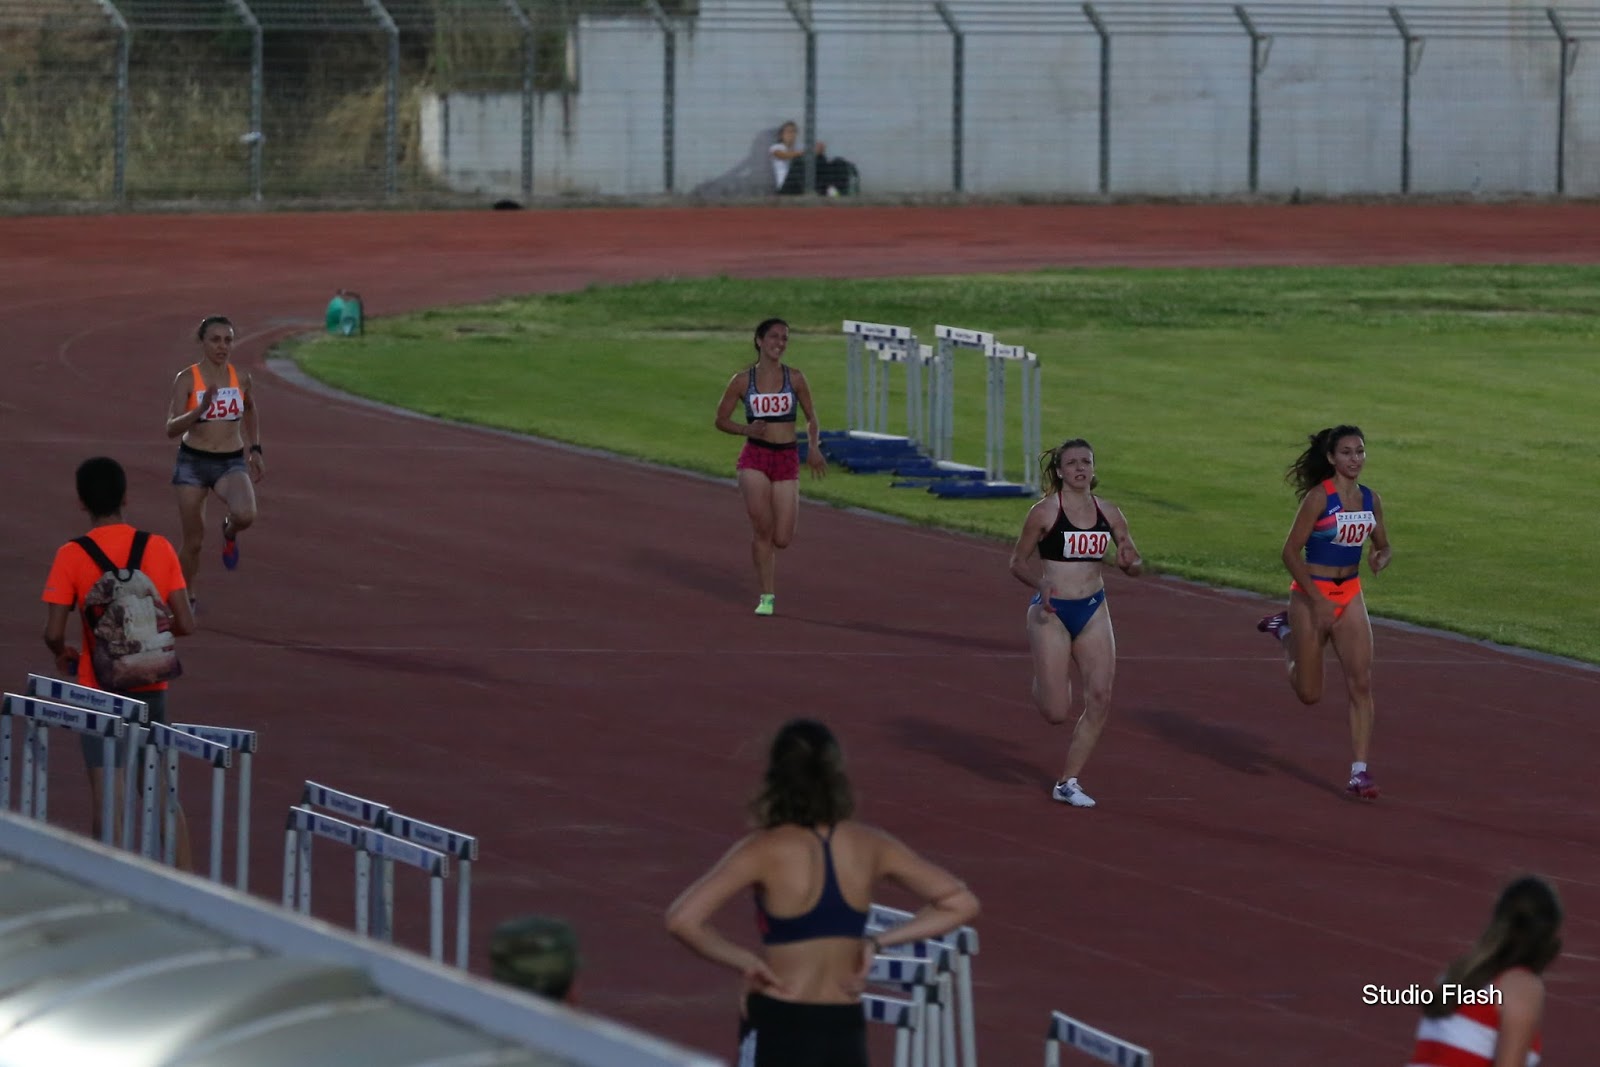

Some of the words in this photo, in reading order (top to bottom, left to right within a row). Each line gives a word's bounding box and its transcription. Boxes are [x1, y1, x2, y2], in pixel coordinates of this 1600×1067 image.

[206, 398, 240, 419] 254
[753, 395, 790, 414] 1033
[1339, 522, 1373, 544] 1031
[1068, 533, 1108, 555] 1030
